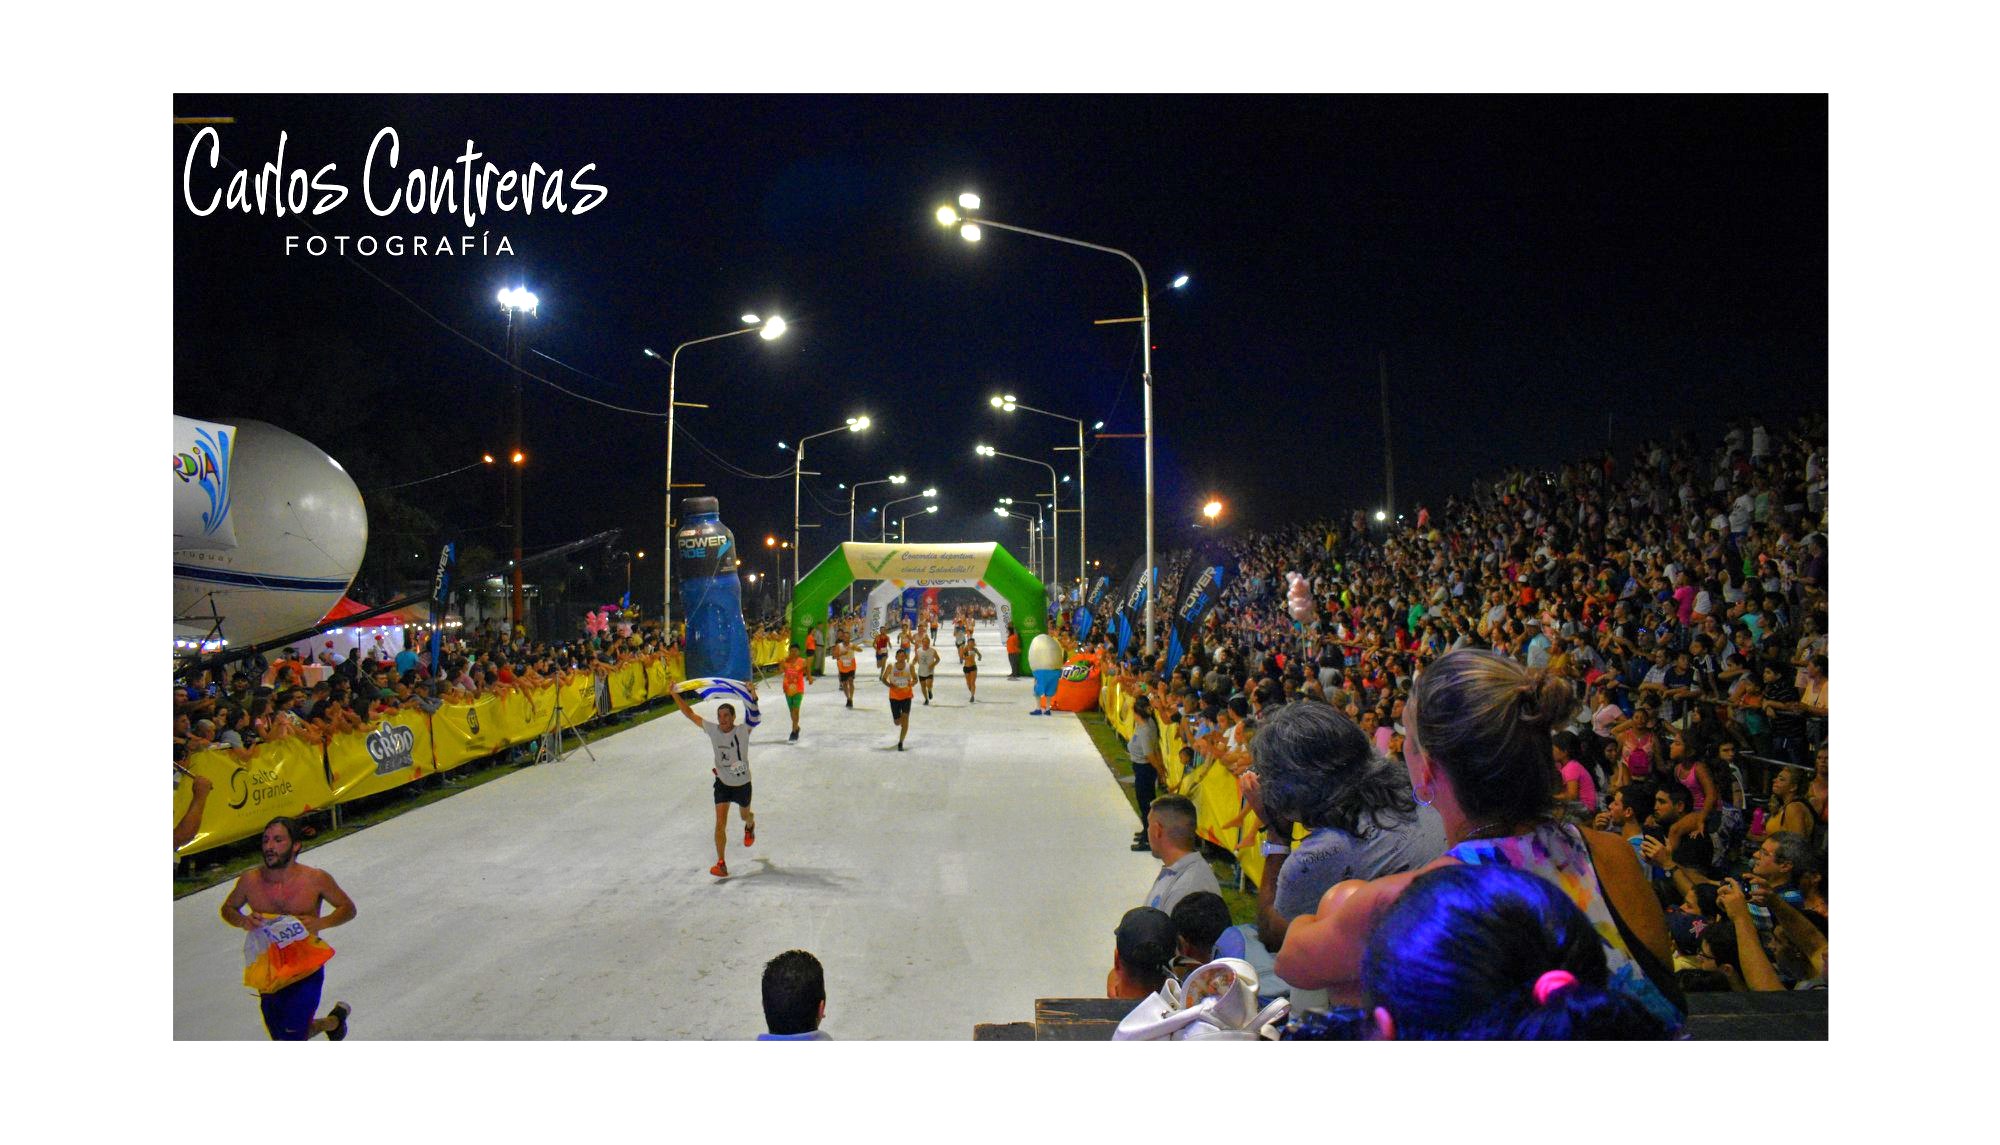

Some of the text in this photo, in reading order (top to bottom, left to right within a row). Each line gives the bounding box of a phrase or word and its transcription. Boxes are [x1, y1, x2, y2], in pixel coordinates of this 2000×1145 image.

[678, 535, 727, 549] POWER
[433, 544, 450, 601] POWER
[1180, 566, 1216, 618] POWER
[252, 769, 279, 786] salto
[252, 780, 294, 806] grande
[272, 922, 305, 943] 1418
